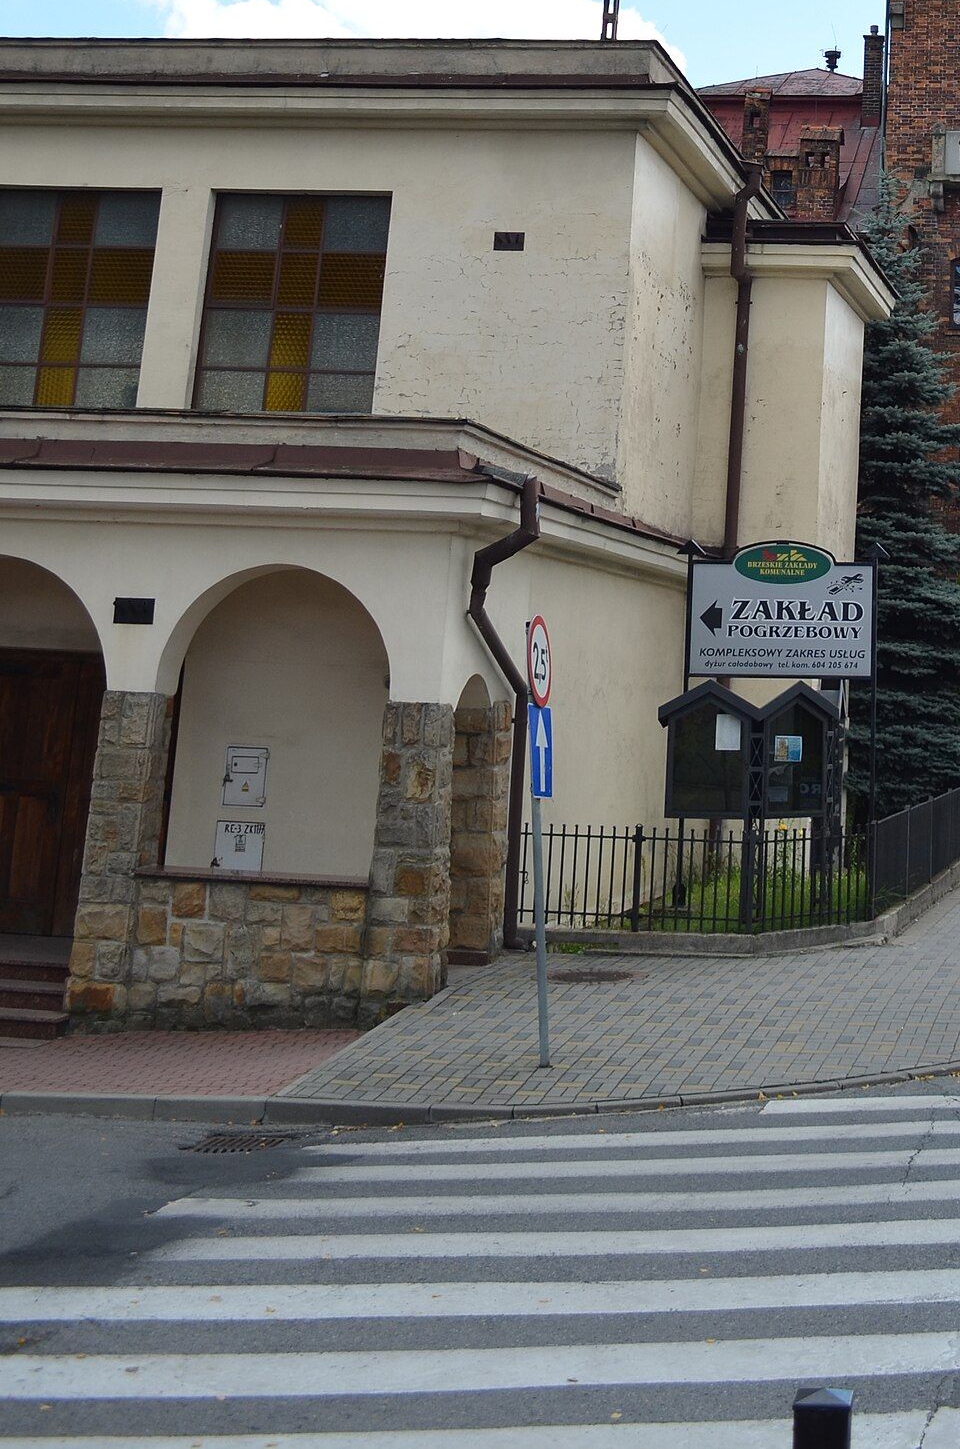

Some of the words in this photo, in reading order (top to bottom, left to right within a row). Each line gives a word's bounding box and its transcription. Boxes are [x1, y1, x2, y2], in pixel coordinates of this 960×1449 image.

[747, 561, 783, 569] BRZESKIE
[784, 562, 818, 570] ZAKŁADY
[759, 568, 805, 576] KOMUNALNE
[731, 599, 864, 622] ZAKŁAD
[727, 625, 862, 640] POGRZEBOWY
[700, 647, 783, 658] KOMPLEKSOWY
[785, 649, 826, 658] ZAKRES
[829, 650, 866, 659] USŁUG
[705, 660, 727, 669] dyżur
[791, 661, 810, 669] kom.
[811, 661, 826, 669] 604
[828, 661, 842, 669] 205
